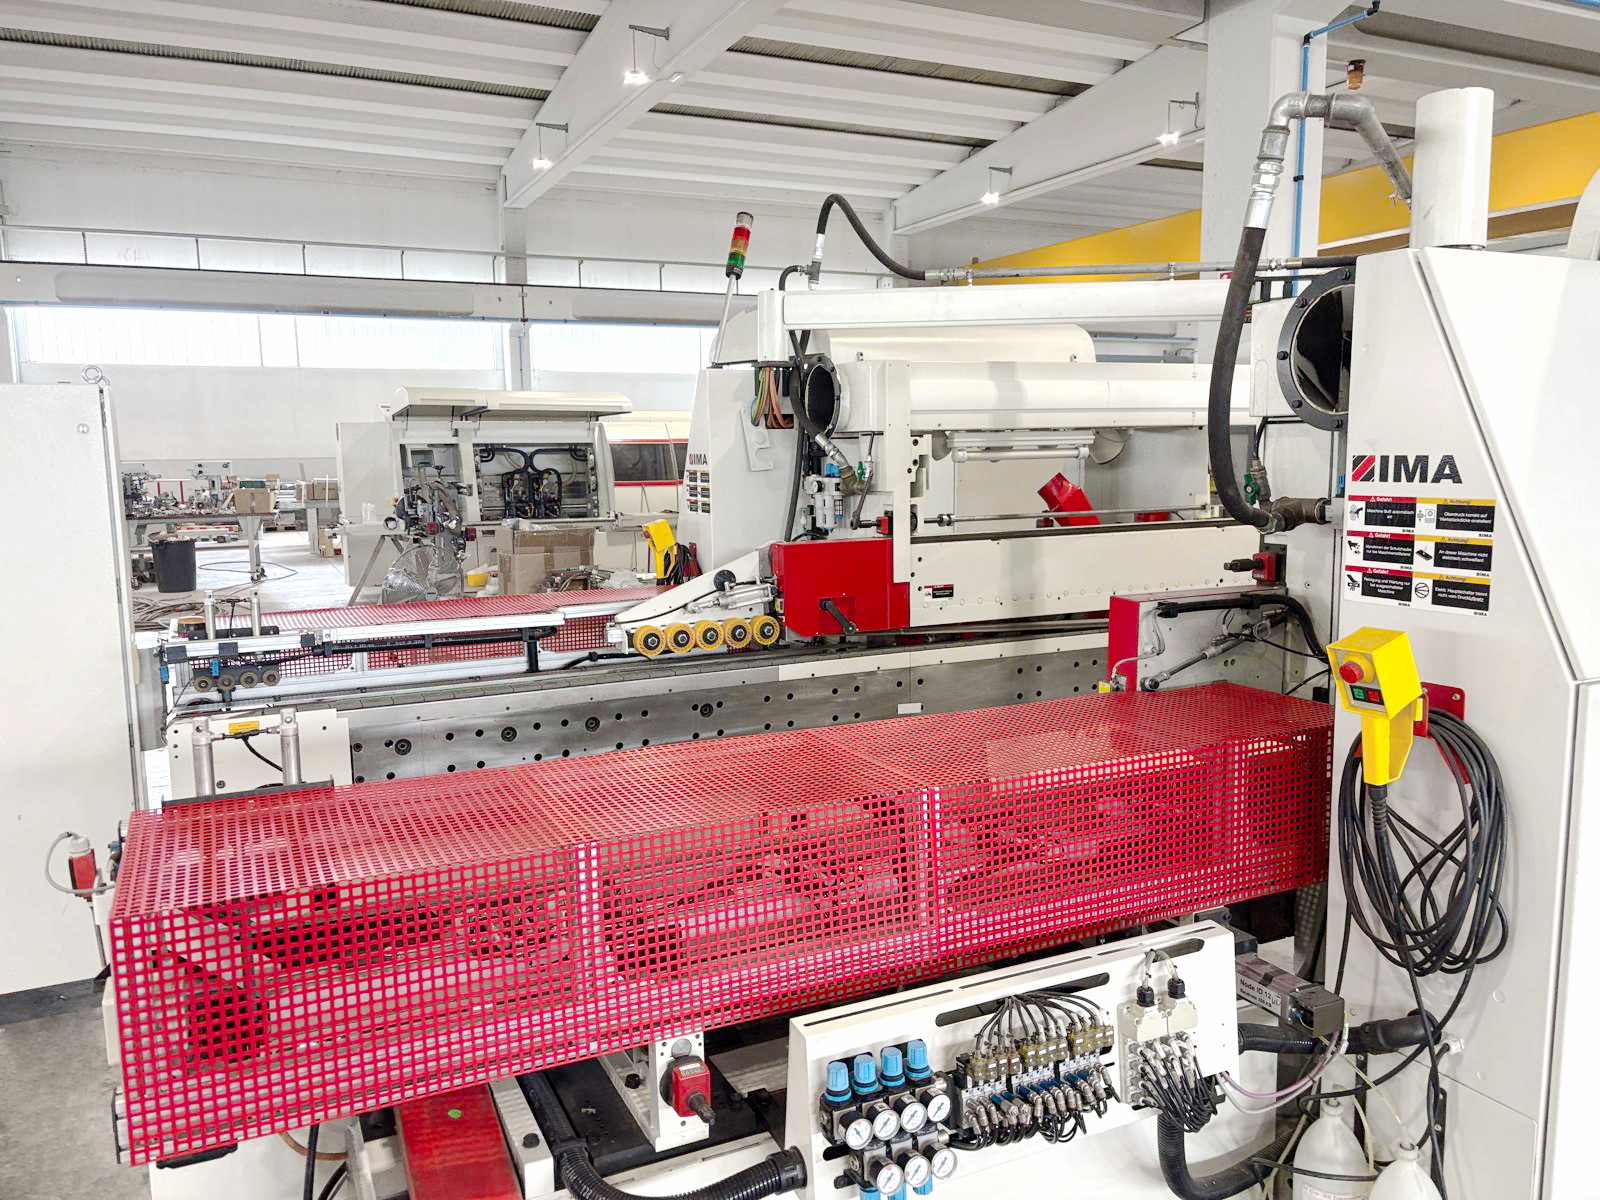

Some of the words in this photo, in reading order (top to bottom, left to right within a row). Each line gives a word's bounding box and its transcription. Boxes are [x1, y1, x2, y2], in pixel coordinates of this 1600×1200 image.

[1379, 455, 1463, 483] IMA
[1240, 979, 1255, 991] Node
[1264, 991, 1271, 999] 12
